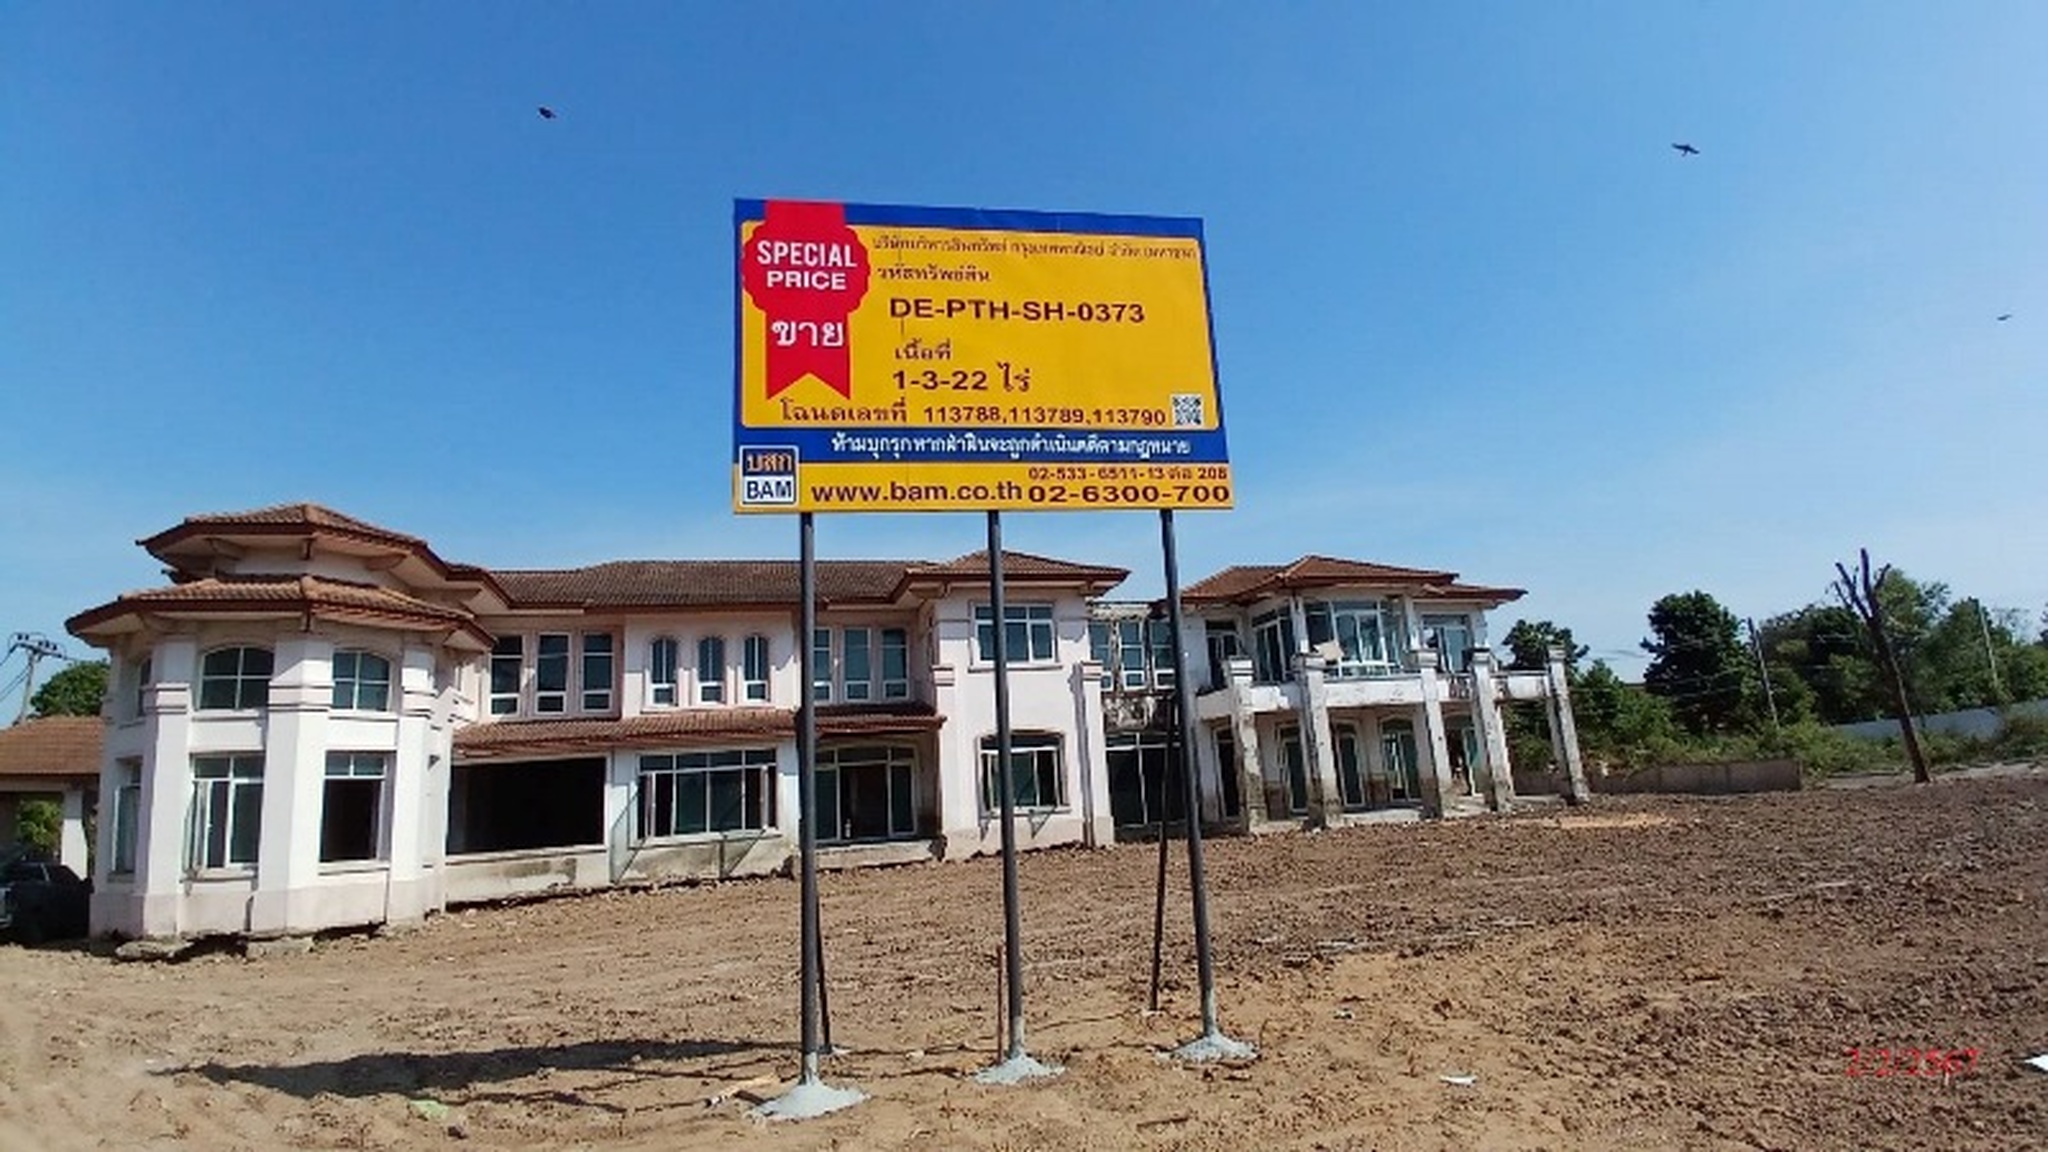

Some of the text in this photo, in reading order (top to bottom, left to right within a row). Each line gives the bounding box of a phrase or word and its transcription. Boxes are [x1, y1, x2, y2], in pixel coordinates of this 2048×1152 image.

[757, 240, 857, 267] SPECIAL
[767, 270, 847, 290] PRICE
[890, 298, 1145, 323] DE-PTH-SH-0373
[771, 321, 844, 347] ขาย
[895, 338, 951, 360] เนื้อที่
[893, 361, 1031, 392] 1-3-22 ไร่
[780, 397, 907, 423] โฉนดเลขที่
[747, 481, 791, 499] BAM
[811, 481, 1230, 502] www.bam.co.th 02-6300-700
